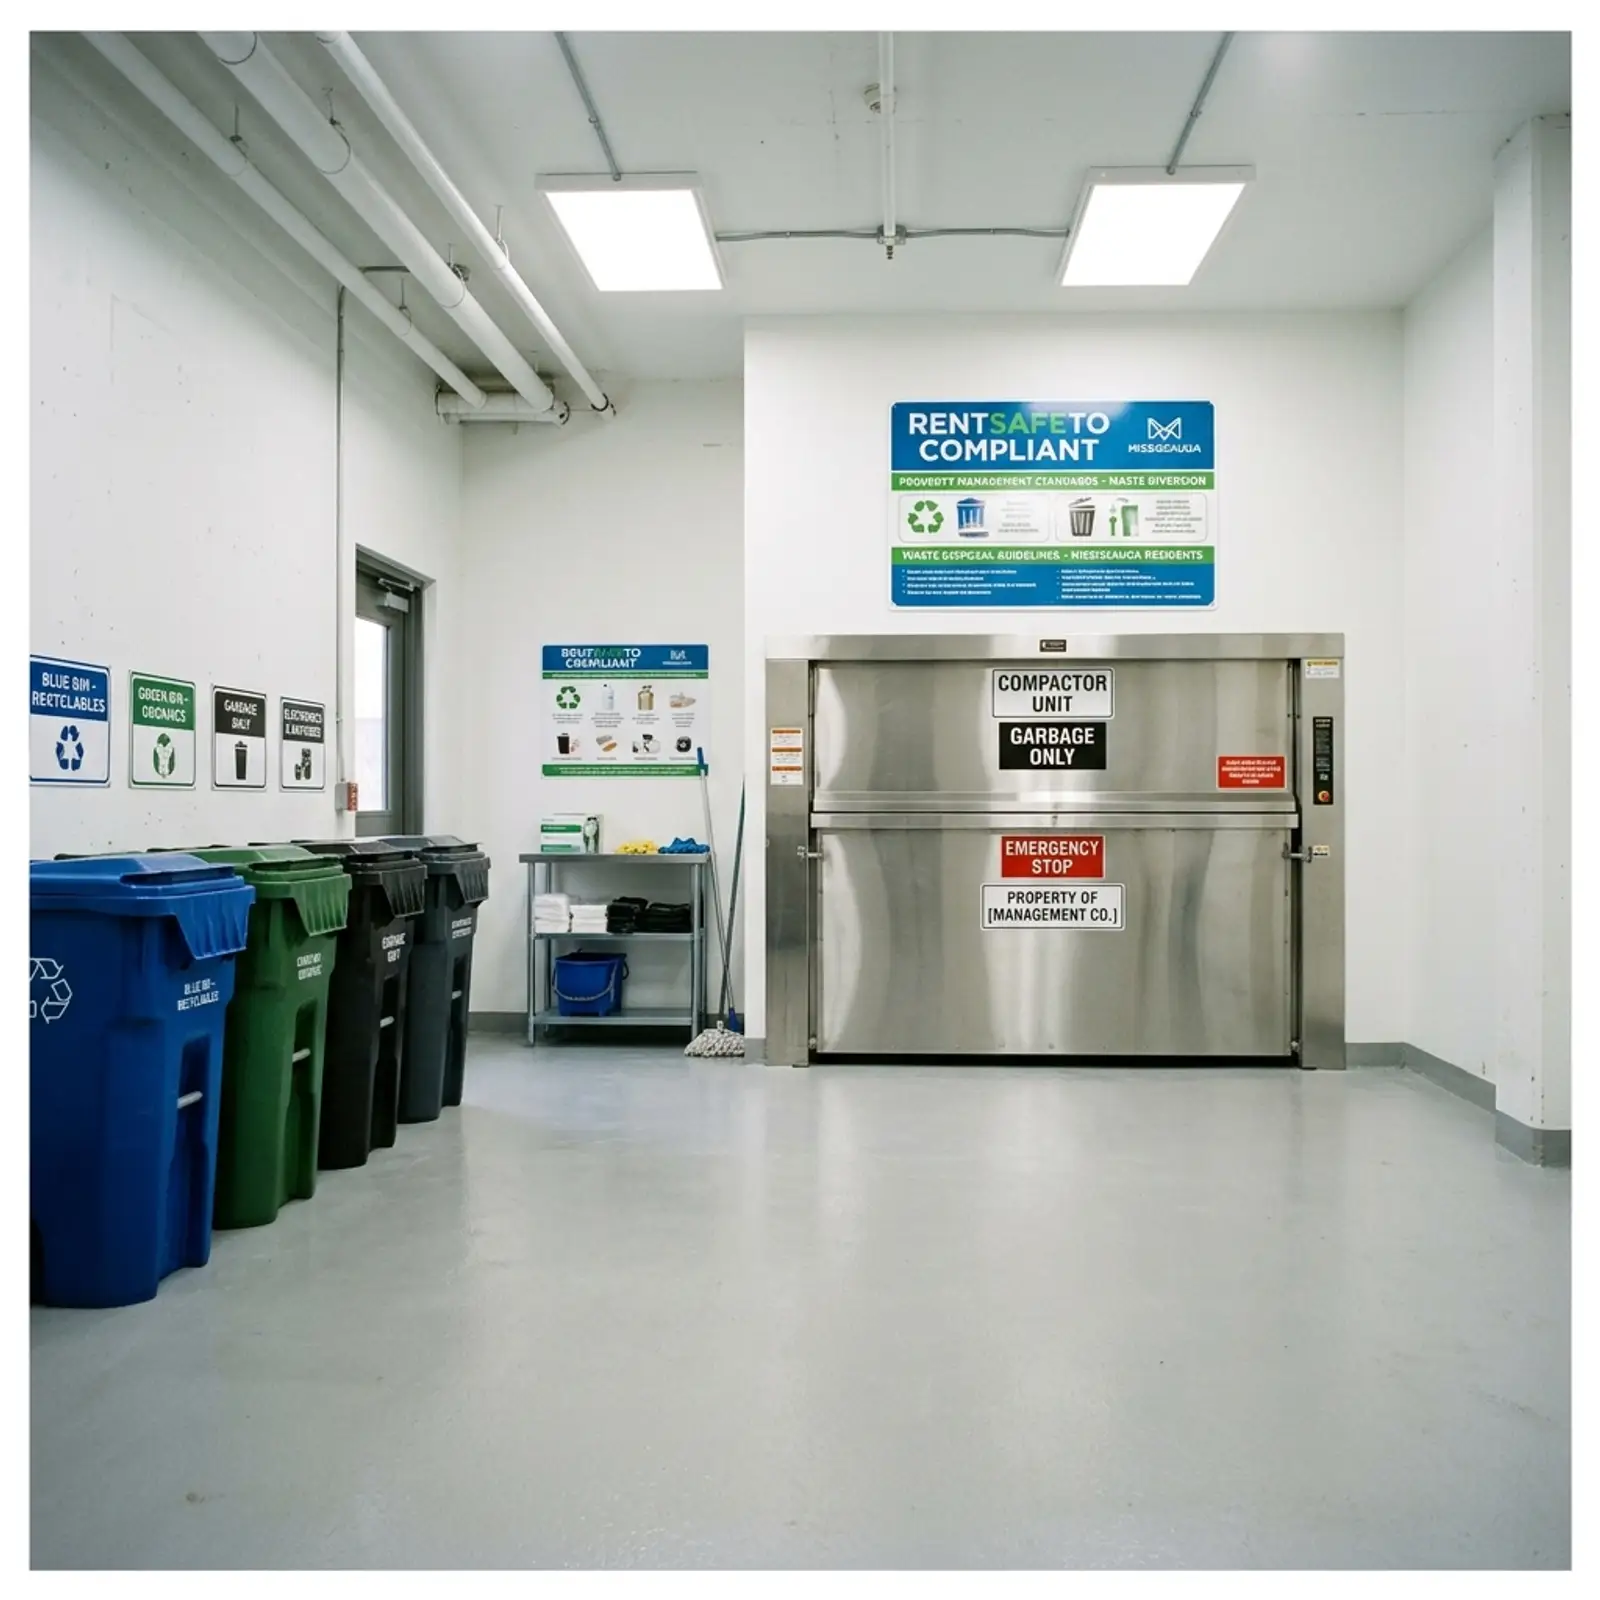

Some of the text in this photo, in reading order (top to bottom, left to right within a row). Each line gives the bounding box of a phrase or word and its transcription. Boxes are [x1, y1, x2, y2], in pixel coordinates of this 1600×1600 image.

[909, 412, 1110, 436] RENTSAFETO
[919, 439, 1100, 462] COMPLIANT
[997, 674, 1108, 693] COMPACTOR
[1032, 695, 1073, 713] UNIT
[1009, 726, 1096, 745] GARBAGE
[1029, 747, 1077, 766] ONLY
[1005, 840, 1100, 856] EMERGENCY
[1031, 859, 1074, 874] STOP
[1006, 891, 1098, 904] PROPERTY OF
[988, 907, 1118, 923] [MANAGEMENT CO.]
